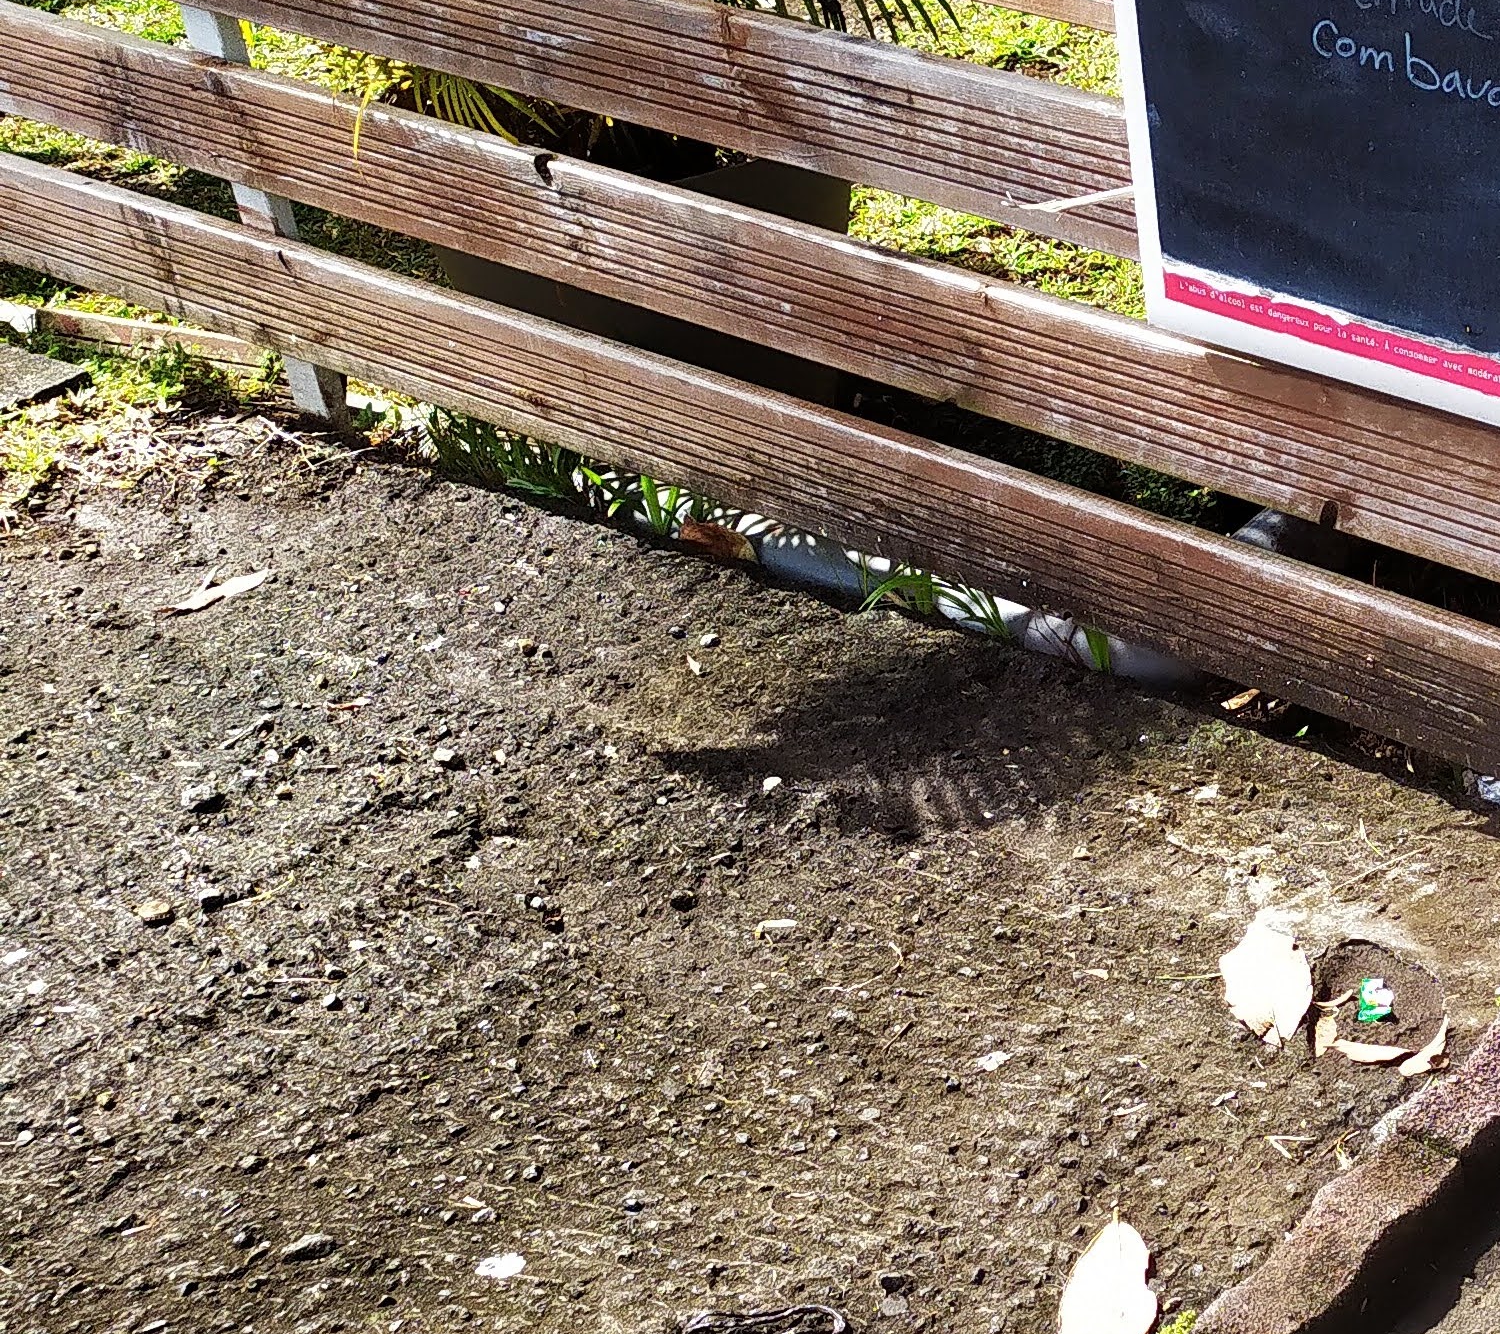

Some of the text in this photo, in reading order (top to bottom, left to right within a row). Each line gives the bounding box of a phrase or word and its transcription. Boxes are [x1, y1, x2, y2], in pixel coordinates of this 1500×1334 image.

[1179, 280, 1207, 297] L'abus
[1209, 290, 1246, 309] d'alcool
[1249, 304, 1264, 314] est
[1267, 308, 1310, 328] dangereux
[1313, 322, 1333, 334] pour
[1336, 327, 1347, 339] la
[1393, 346, 1440, 365] consommer
[1442, 359, 1464, 373] avec
